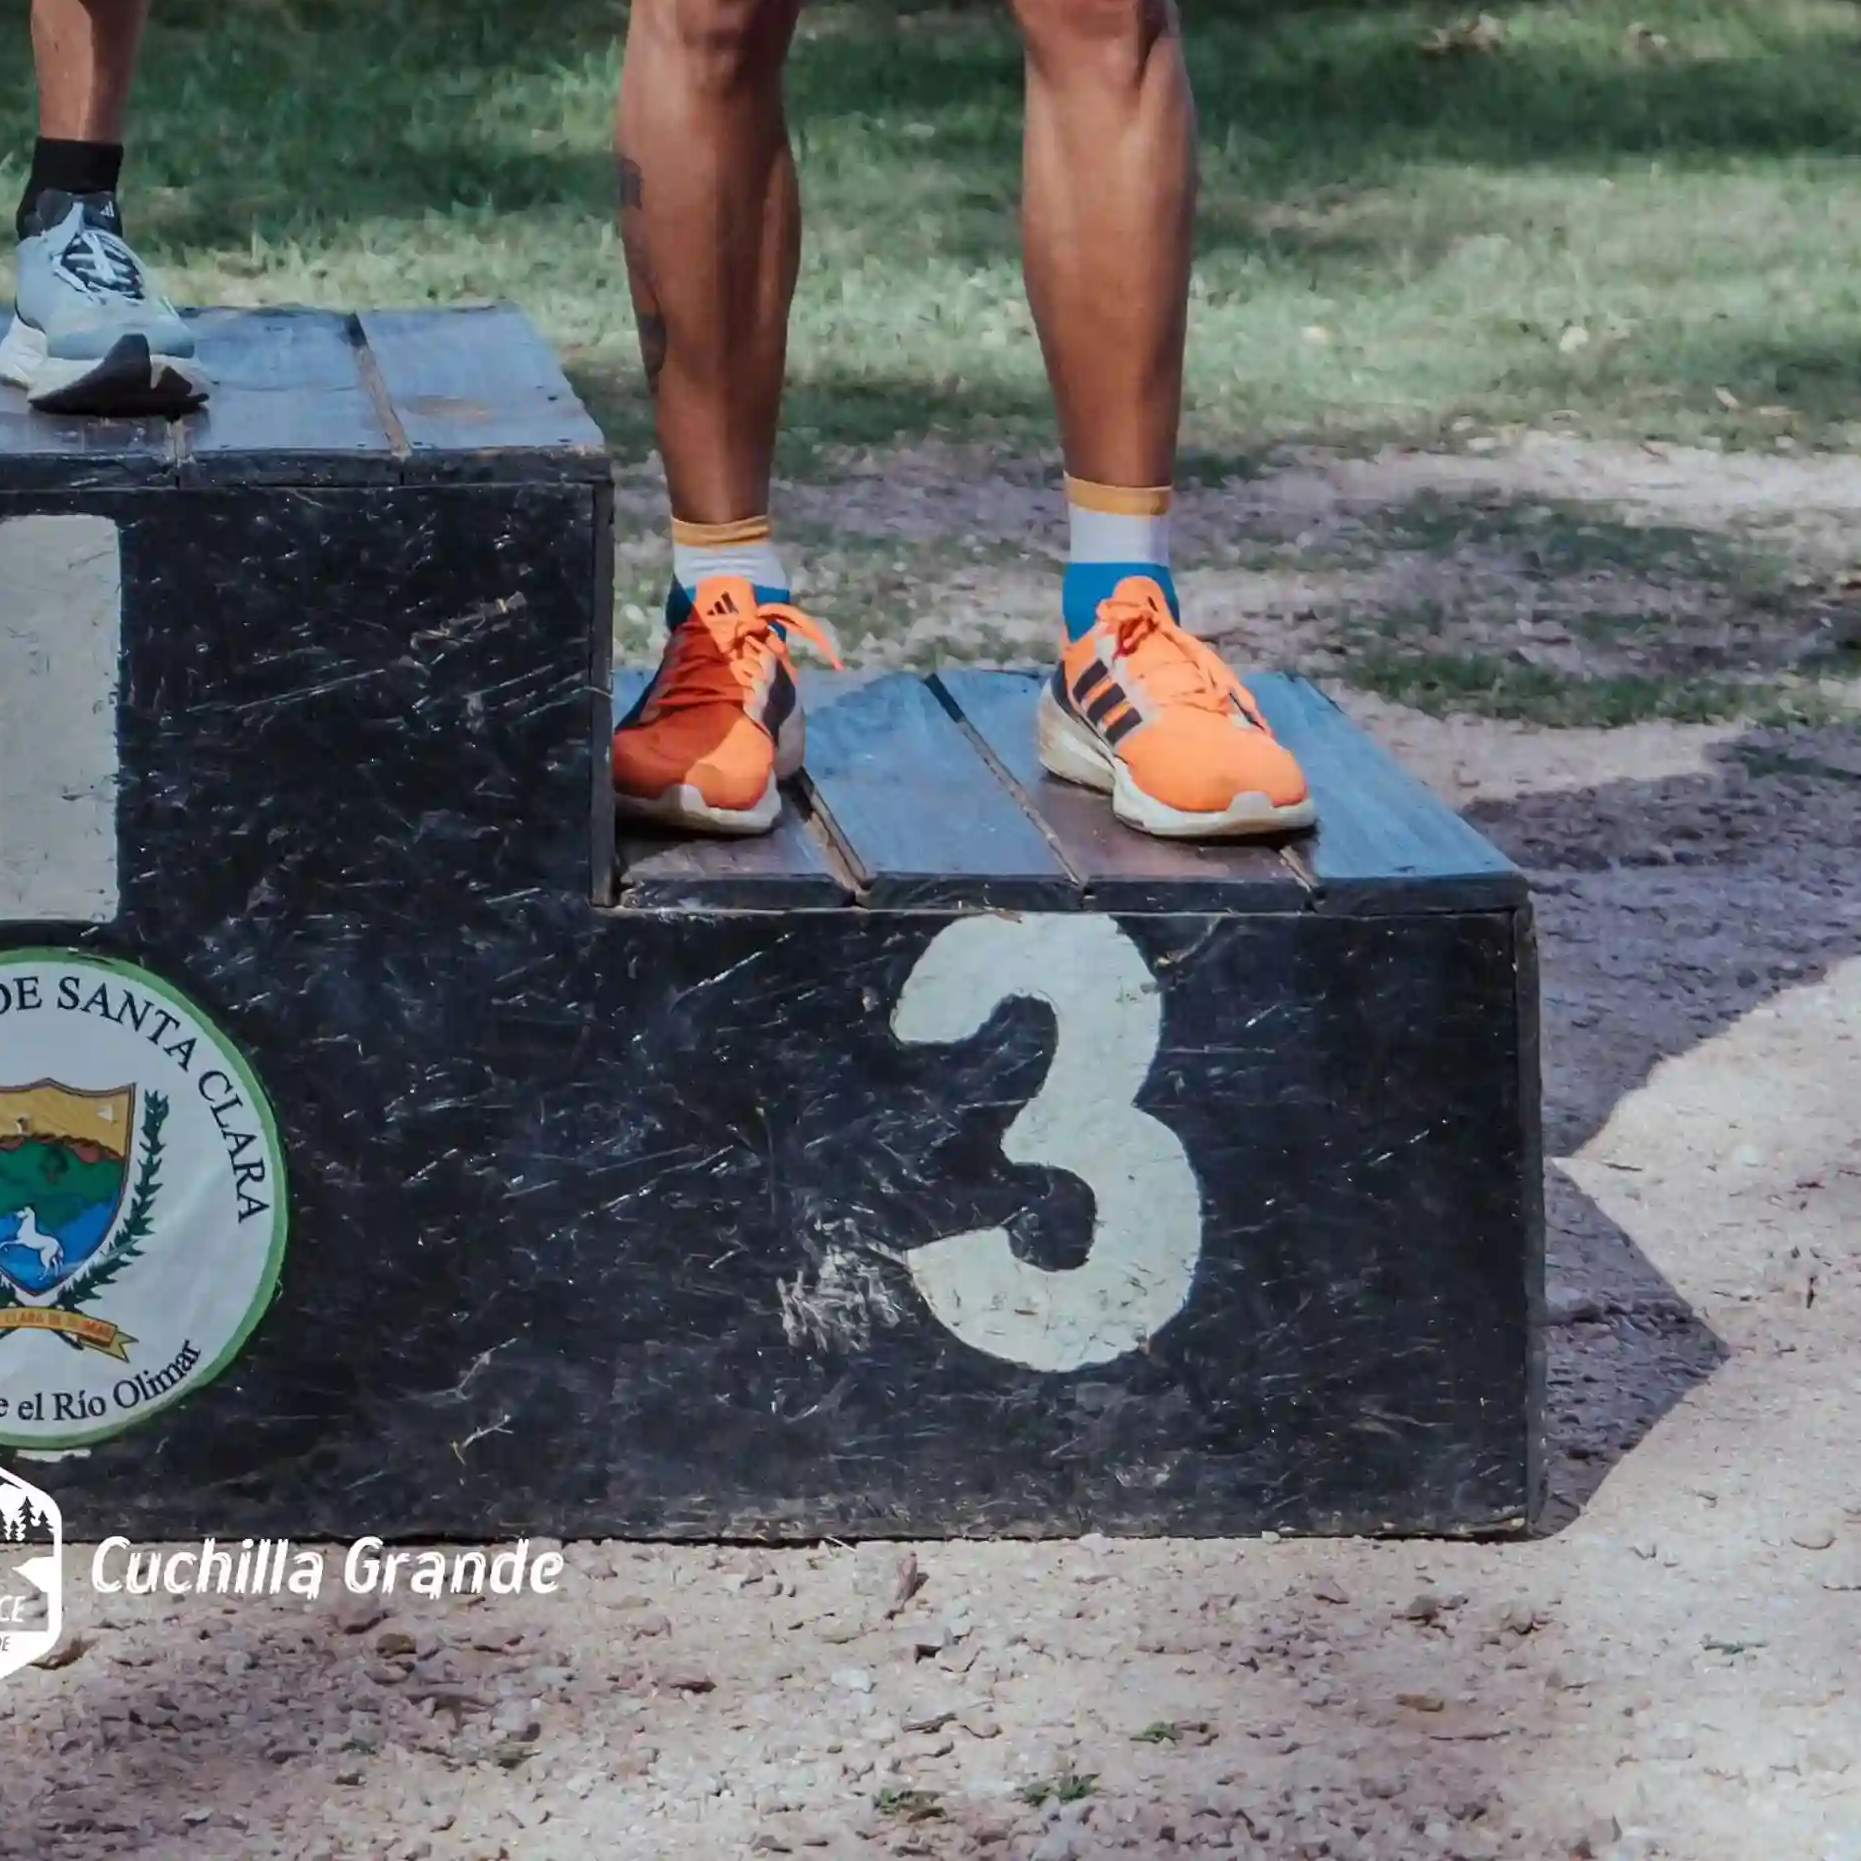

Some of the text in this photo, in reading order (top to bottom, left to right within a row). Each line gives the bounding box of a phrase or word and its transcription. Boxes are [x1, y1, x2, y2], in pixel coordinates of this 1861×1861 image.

[57, 976, 198, 1072] SANTA
[197, 1068, 271, 1224] CLARA
[889, 913, 1202, 1372] 3
[18, 1394, 44, 1421] el
[53, 1391, 106, 1422] Río
[114, 1338, 201, 1411] Olimar
